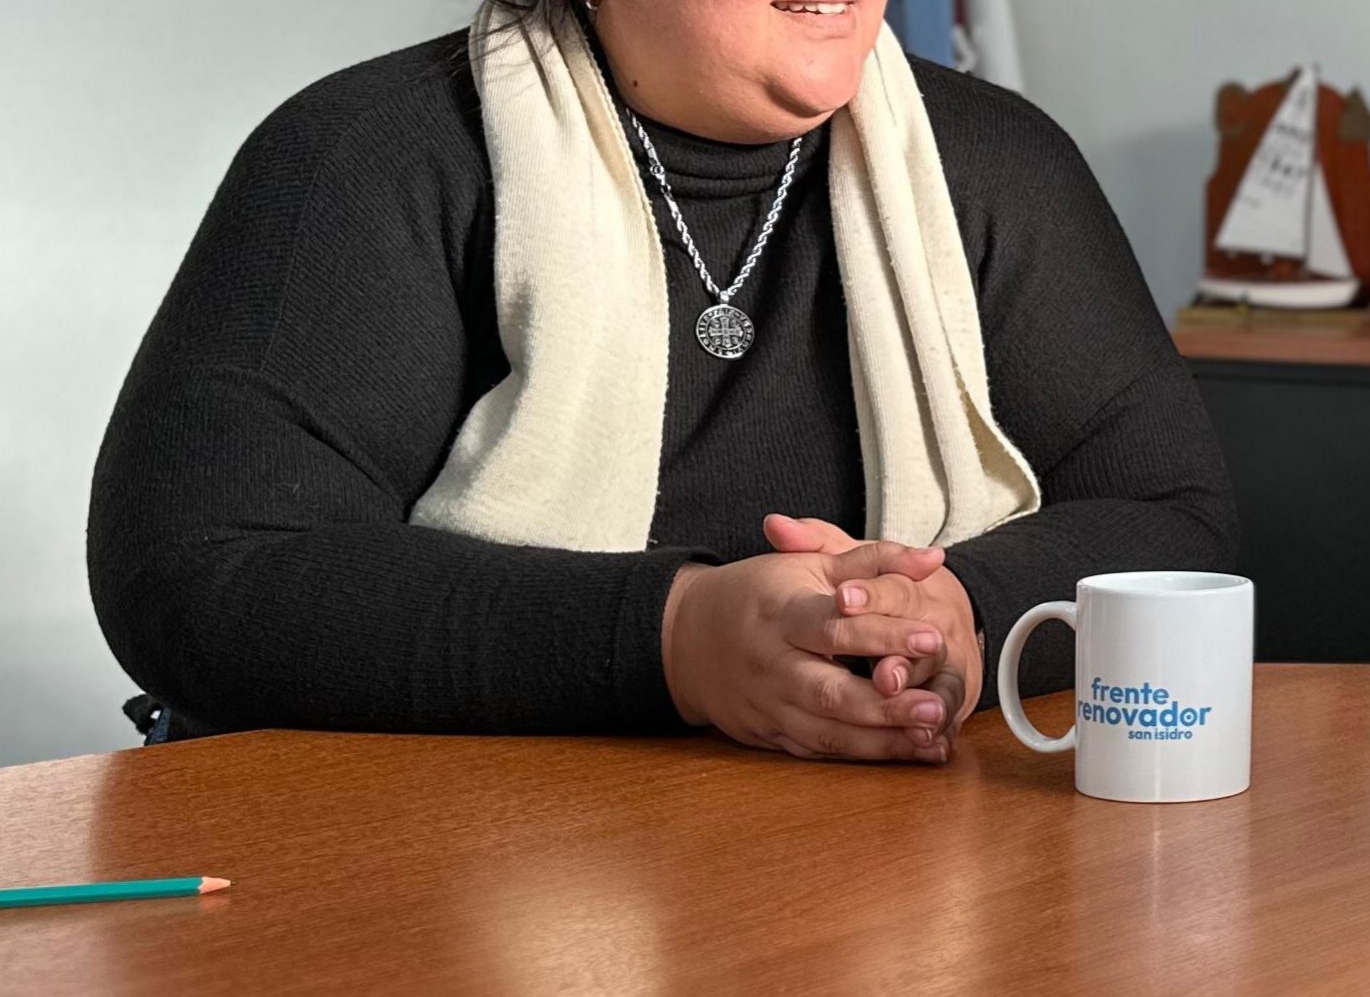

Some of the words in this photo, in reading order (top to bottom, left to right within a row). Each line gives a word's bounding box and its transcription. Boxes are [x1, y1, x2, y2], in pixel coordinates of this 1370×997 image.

[1091, 677, 1170, 705] frente
[1078, 700, 1212, 728] renovador
[1127, 728, 1152, 740] san
[1154, 727, 1193, 741] isidro
